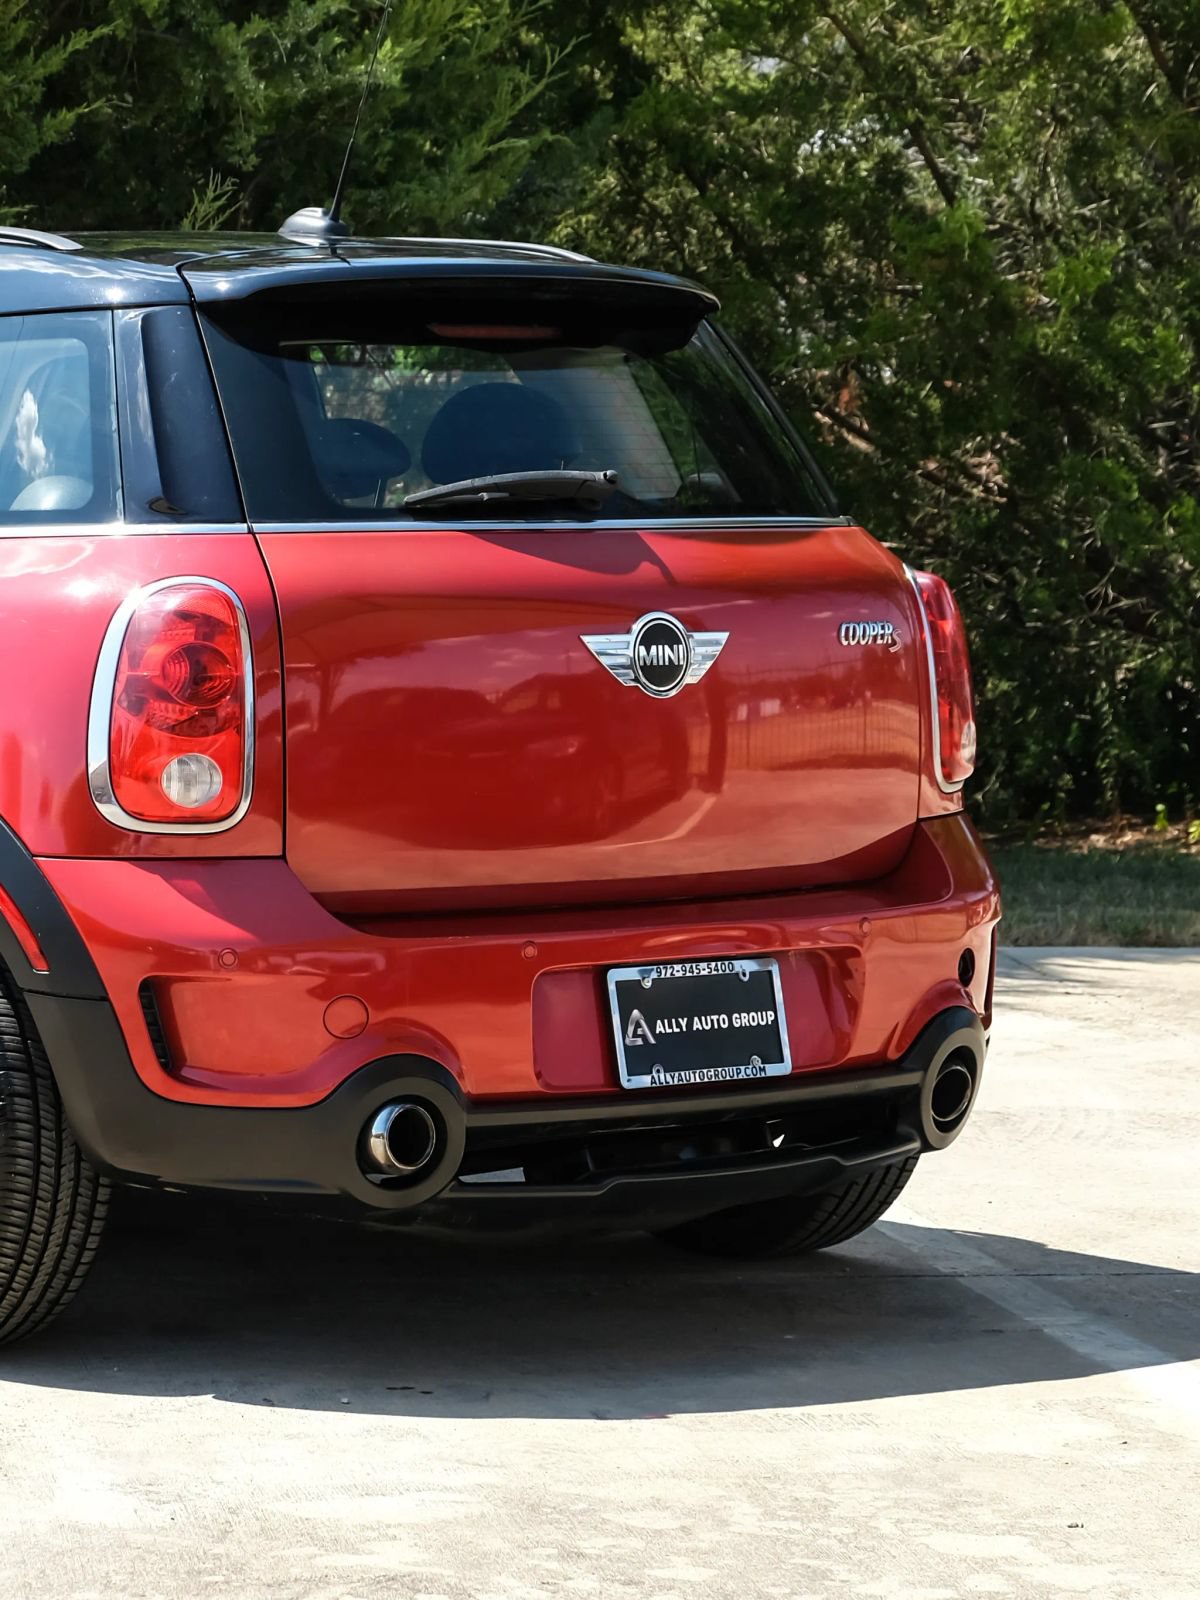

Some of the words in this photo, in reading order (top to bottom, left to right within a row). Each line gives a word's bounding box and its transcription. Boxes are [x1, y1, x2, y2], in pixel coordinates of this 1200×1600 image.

[839, 621, 894, 646] COOPER
[888, 629, 903, 653] S
[638, 644, 684, 666] MINI
[655, 961, 735, 978] 972-945-5400
[655, 1017, 688, 1034] ALLY
[693, 1014, 729, 1031] AUTO
[733, 1010, 775, 1027] GROUP
[650, 1065, 767, 1087] ALLYAUTOGROUP.COM
